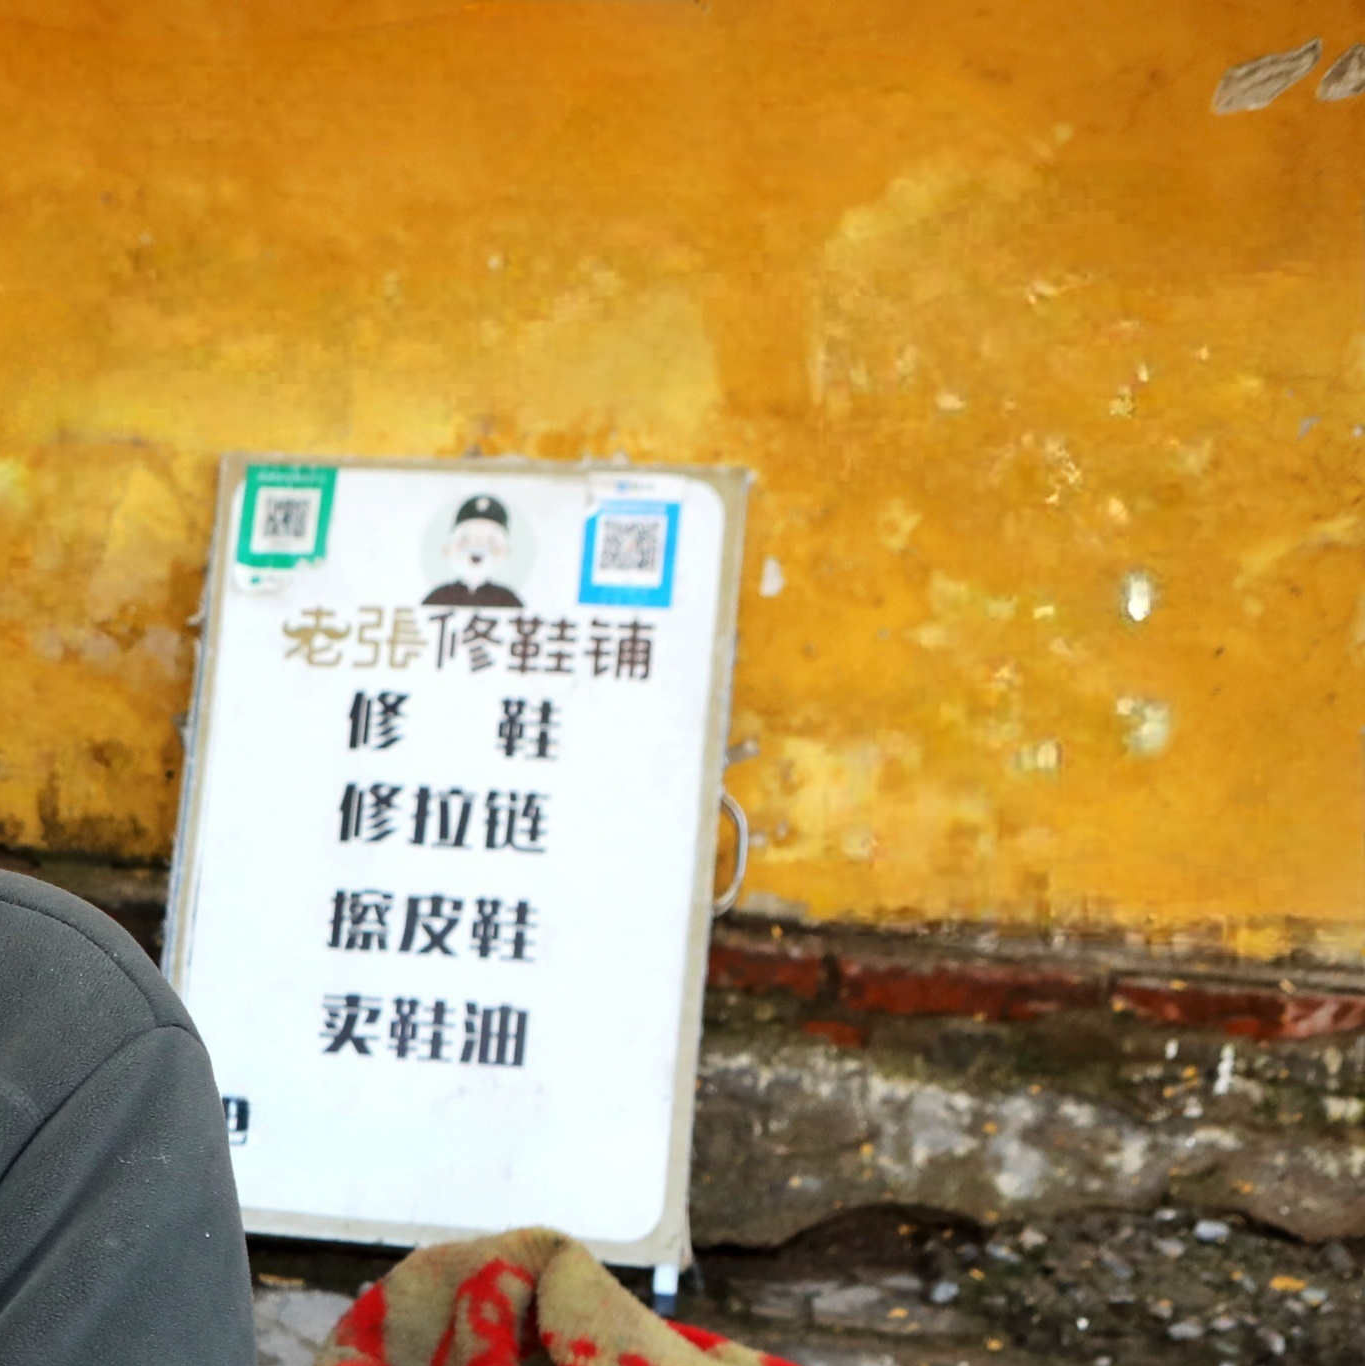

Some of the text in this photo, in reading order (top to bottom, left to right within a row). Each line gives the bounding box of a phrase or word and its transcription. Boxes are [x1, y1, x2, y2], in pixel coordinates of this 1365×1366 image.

[348, 689, 563, 762] 修 鞋
[338, 780, 550, 854] 修拉链
[325, 888, 541, 963] 擦皮鞋
[317, 993, 531, 1069] 卖鞋油
